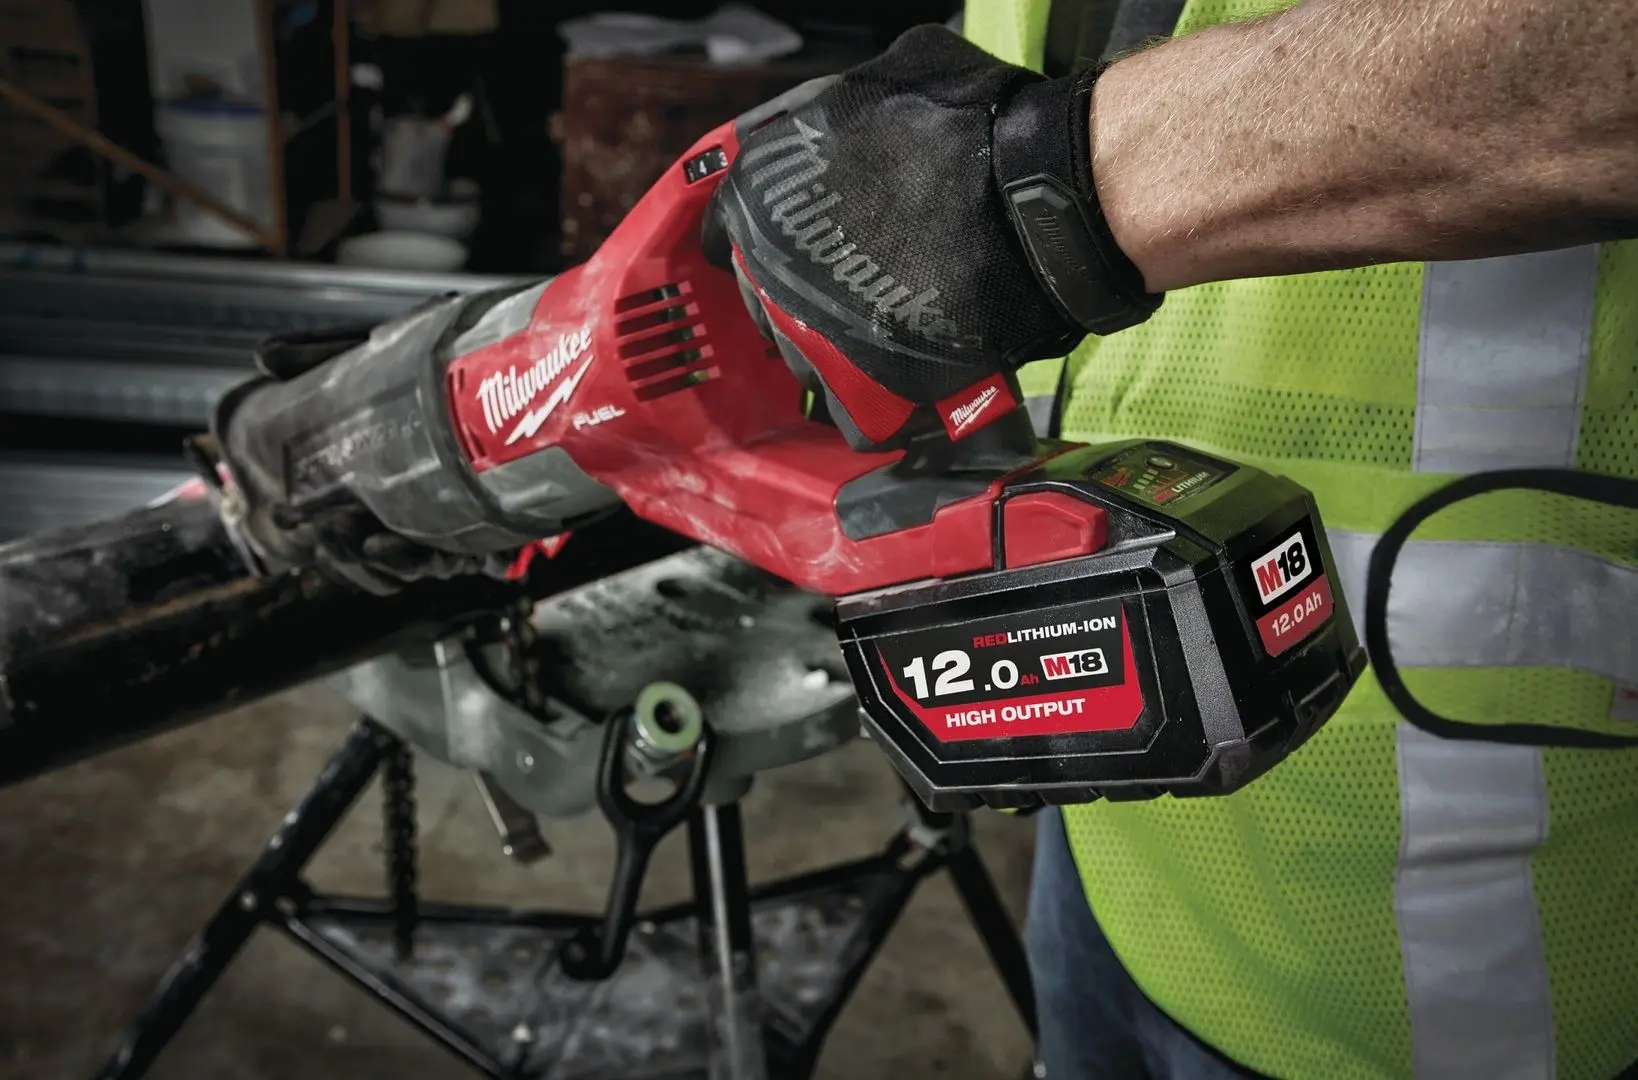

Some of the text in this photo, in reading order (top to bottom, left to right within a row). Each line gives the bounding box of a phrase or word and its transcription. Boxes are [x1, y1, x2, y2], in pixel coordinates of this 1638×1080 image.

[475, 323, 593, 436] Milwaukee
[572, 404, 627, 431] FUEL
[949, 385, 997, 427] Milwaukee
[1255, 541, 1306, 597] M18
[972, 616, 1117, 648] REDLITHIUM-ION
[1043, 651, 1103, 678] M18
[945, 698, 1086, 728] HIGH OUTPUT
